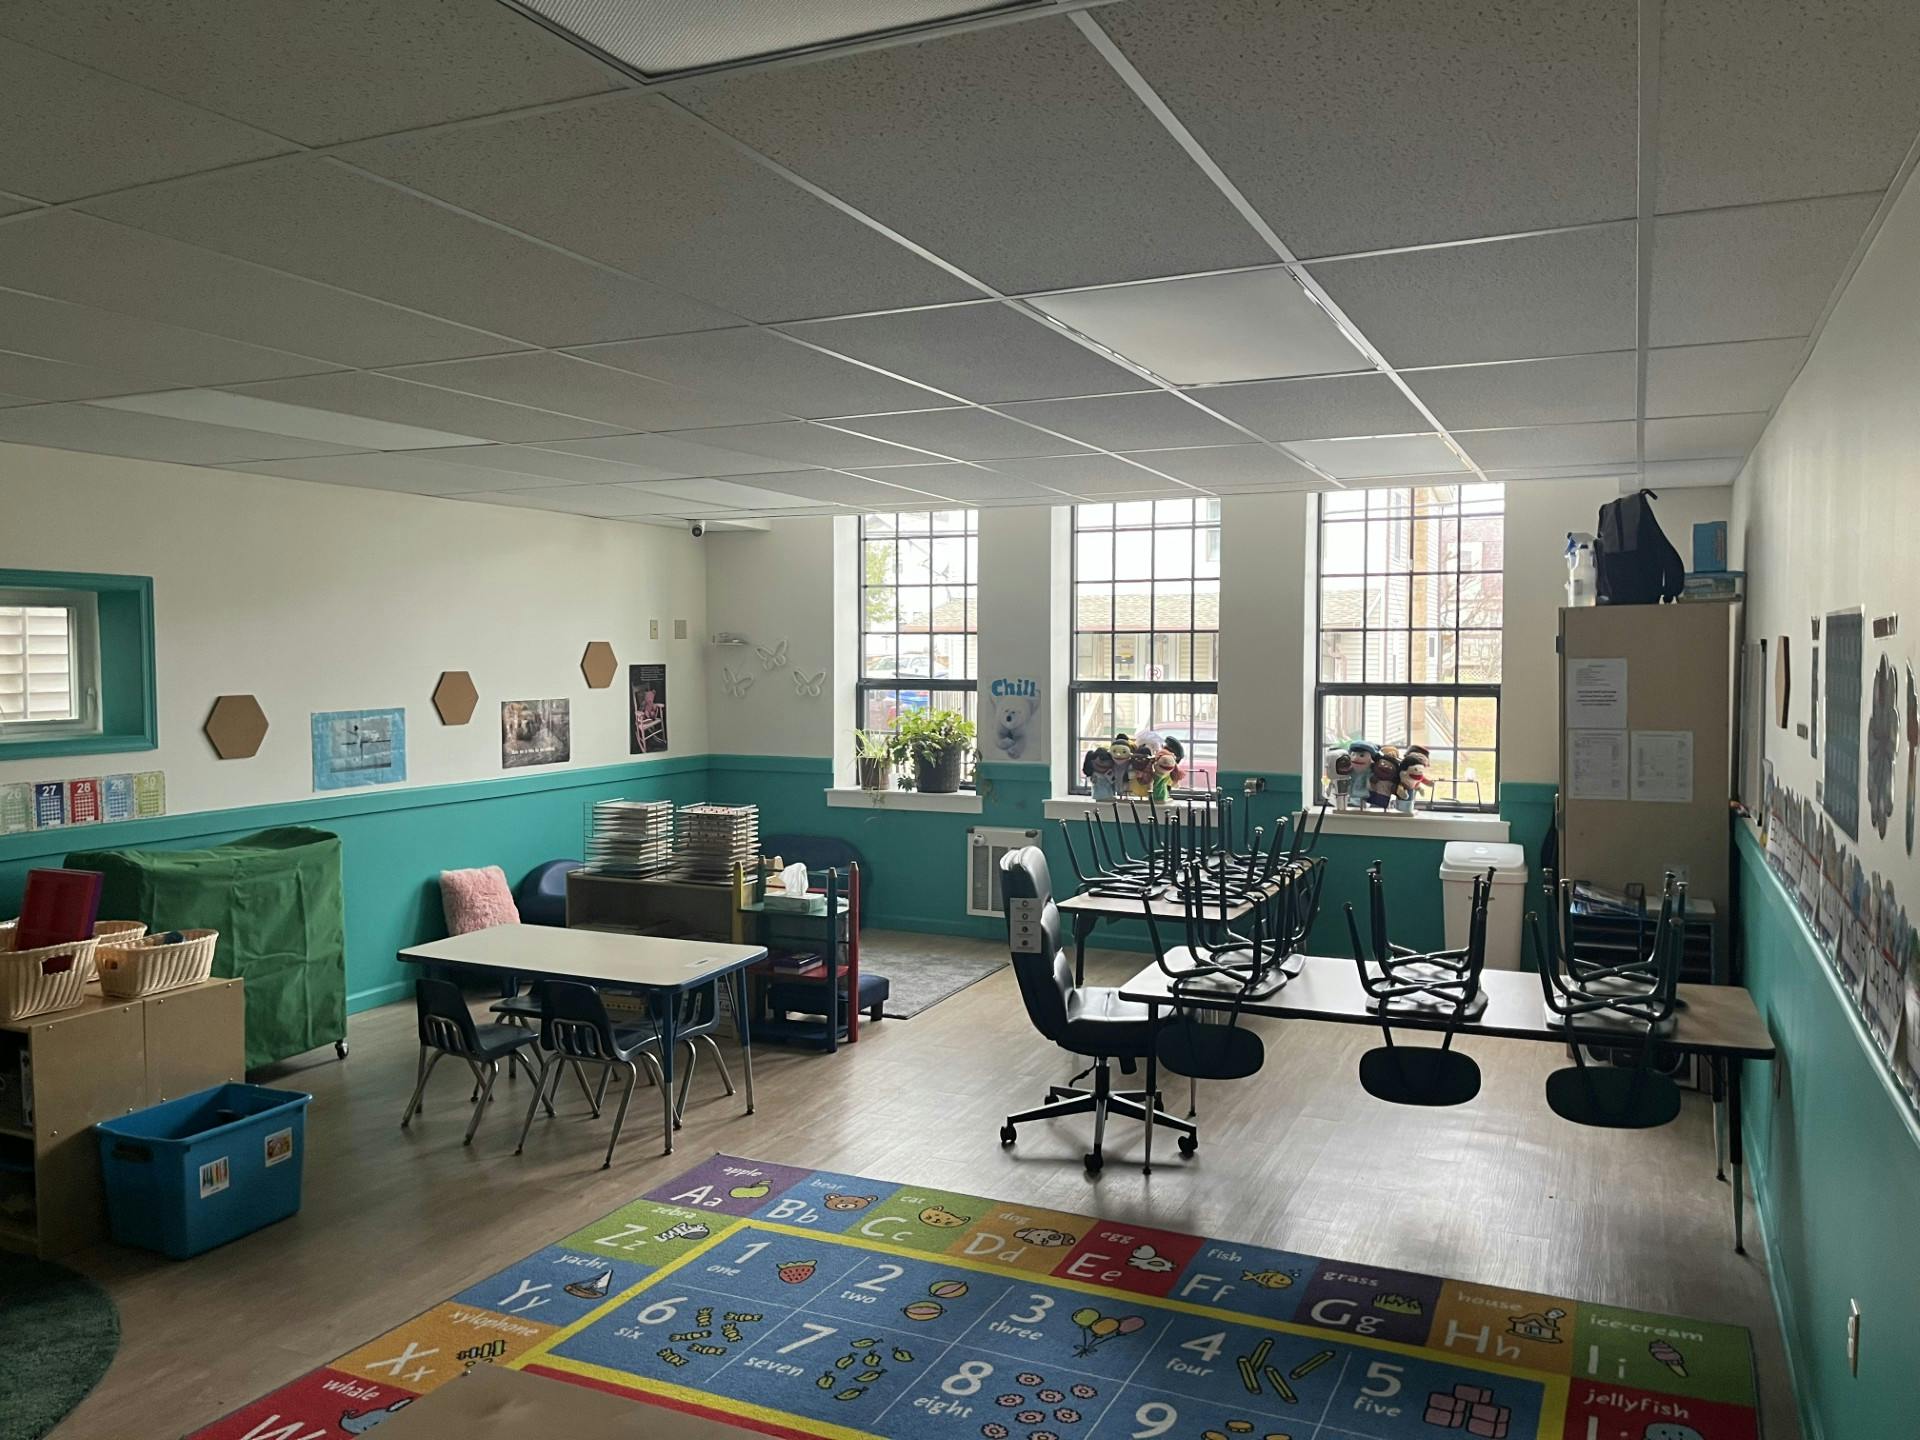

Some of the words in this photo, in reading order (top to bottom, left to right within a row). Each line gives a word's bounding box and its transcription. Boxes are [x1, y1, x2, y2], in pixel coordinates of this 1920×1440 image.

[992, 678, 1035, 696] Chill
[42, 785, 57, 797] 27
[77, 783, 91, 794] 28
[111, 779, 125, 791] 29
[723, 1165, 763, 1178] apple
[670, 1185, 723, 1208] Aa
[811, 1179, 846, 1192] bear
[766, 1199, 820, 1223] Bb
[900, 1194, 926, 1205] cat
[652, 1205, 697, 1220] zebra
[999, 1211, 1032, 1225] dog
[594, 1224, 648, 1250] Zz
[860, 1217, 913, 1241] Cc
[1100, 1231, 1134, 1244] egg
[735, 1242, 772, 1264] 1
[963, 1232, 1026, 1263] Dd
[1208, 1248, 1242, 1262] fish
[554, 1252, 606, 1269] yacht
[707, 1264, 739, 1277] one
[1066, 1253, 1122, 1282] Ee
[854, 1264, 904, 1292] 2
[1180, 1273, 1235, 1301] Ff
[1323, 1270, 1379, 1287] grass
[498, 1280, 552, 1312] Yy
[840, 1291, 877, 1304] two
[1458, 1291, 1523, 1311] house
[637, 1297, 688, 1325] 6
[1009, 1294, 1054, 1323] 3
[1310, 1299, 1384, 1334] Gg
[449, 1310, 539, 1337] xylophone
[614, 1325, 644, 1340] six
[988, 1321, 1043, 1341] three
[1590, 1314, 1703, 1342] ice-cream
[776, 1323, 839, 1354] 7
[1180, 1332, 1226, 1361] 4
[1444, 1320, 1521, 1359] Hh
[365, 1343, 440, 1382] Xx
[744, 1357, 804, 1377] seven
[1165, 1358, 1214, 1377] four
[322, 1378, 380, 1401] whale
[941, 1361, 994, 1395] 8
[1360, 1361, 1404, 1397] 5
[913, 1395, 973, 1418] eight
[1353, 1396, 1402, 1417] five
[1584, 1389, 1690, 1419] jellyfish
[1132, 1402, 1177, 1440] 9
